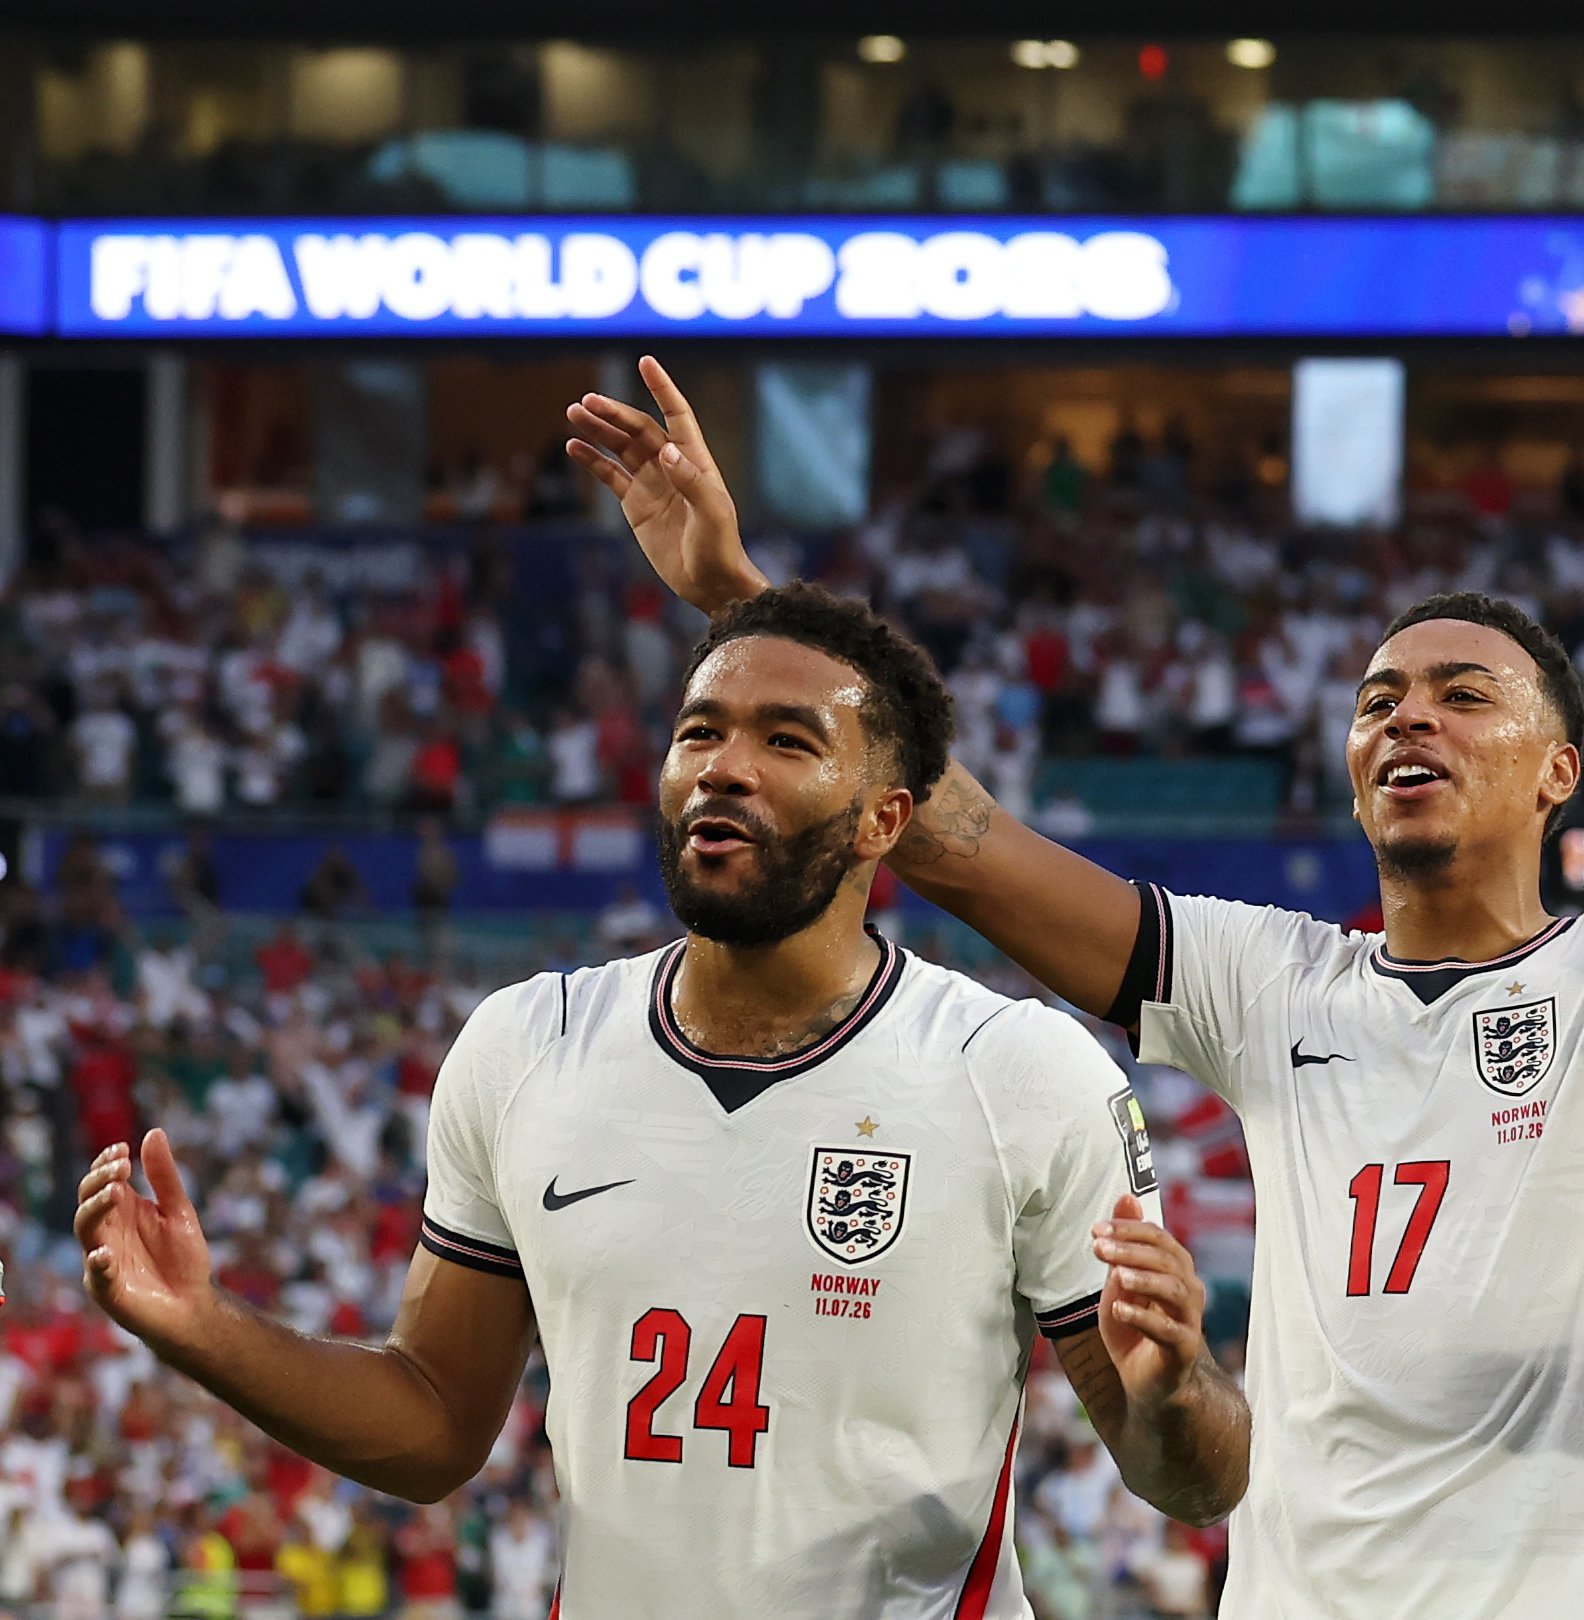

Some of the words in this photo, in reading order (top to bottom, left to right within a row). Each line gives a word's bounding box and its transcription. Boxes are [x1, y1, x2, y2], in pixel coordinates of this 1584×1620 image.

[90, 233, 297, 320] FIFA
[294, 232, 637, 320] WORLD
[640, 231, 836, 320] CUP
[835, 230, 1173, 320] 2026
[1491, 1100, 1547, 1127] NORWAY
[1497, 1122, 1543, 1145] 11.07.26
[1347, 1160, 1451, 1297] 17
[810, 1273, 881, 1297] NORWAY
[815, 1297, 872, 1319] 11.07.26
[624, 1307, 770, 1469] 24
